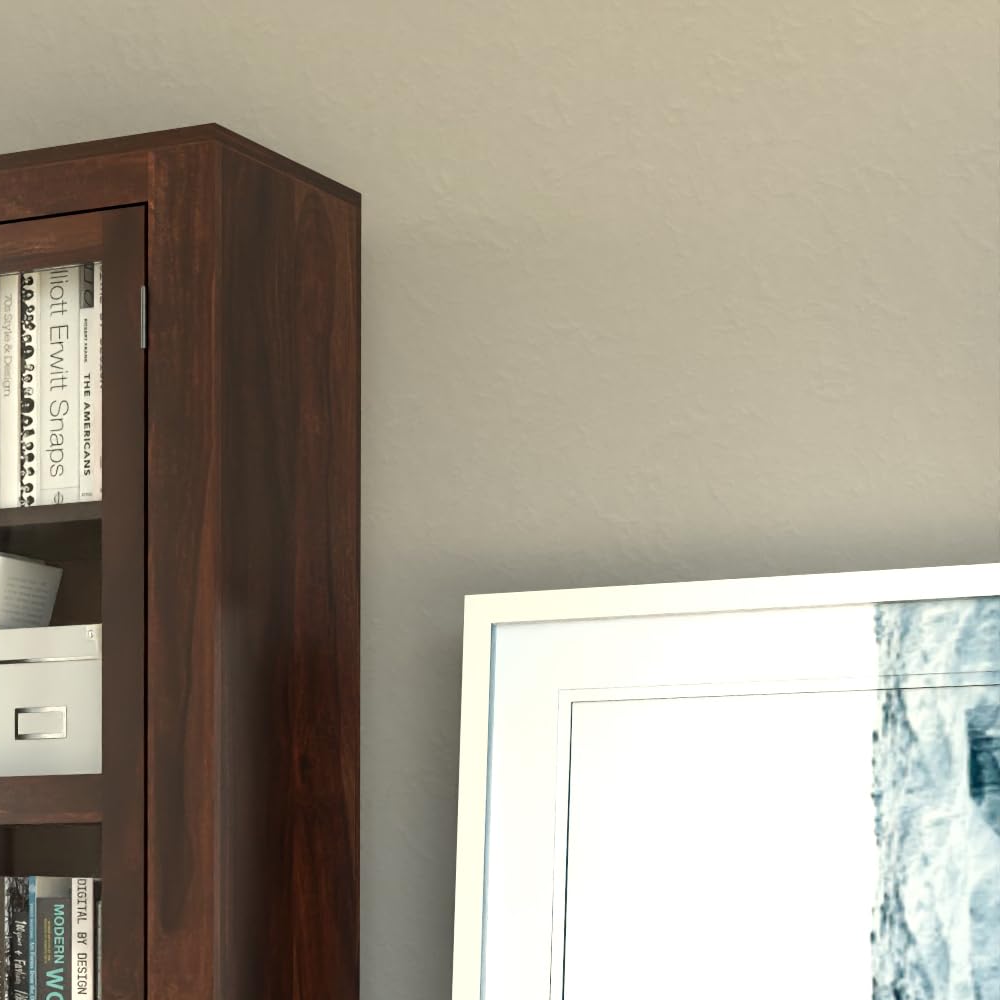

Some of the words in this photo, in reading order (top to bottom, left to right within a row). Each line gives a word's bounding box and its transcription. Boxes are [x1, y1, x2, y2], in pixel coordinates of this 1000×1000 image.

[49, 270, 69, 316] lliott
[2, 313, 13, 342] Style
[49, 324, 69, 392] Erwitt
[83, 373, 91, 397] THE
[45, 399, 70, 478] Snaps
[83, 401, 91, 476] AMERICANS
[77, 878, 87, 925] DIGITAL
[53, 904, 65, 964] MODERN
[77, 931, 87, 945] BY
[77, 952, 87, 995] DESIGN
